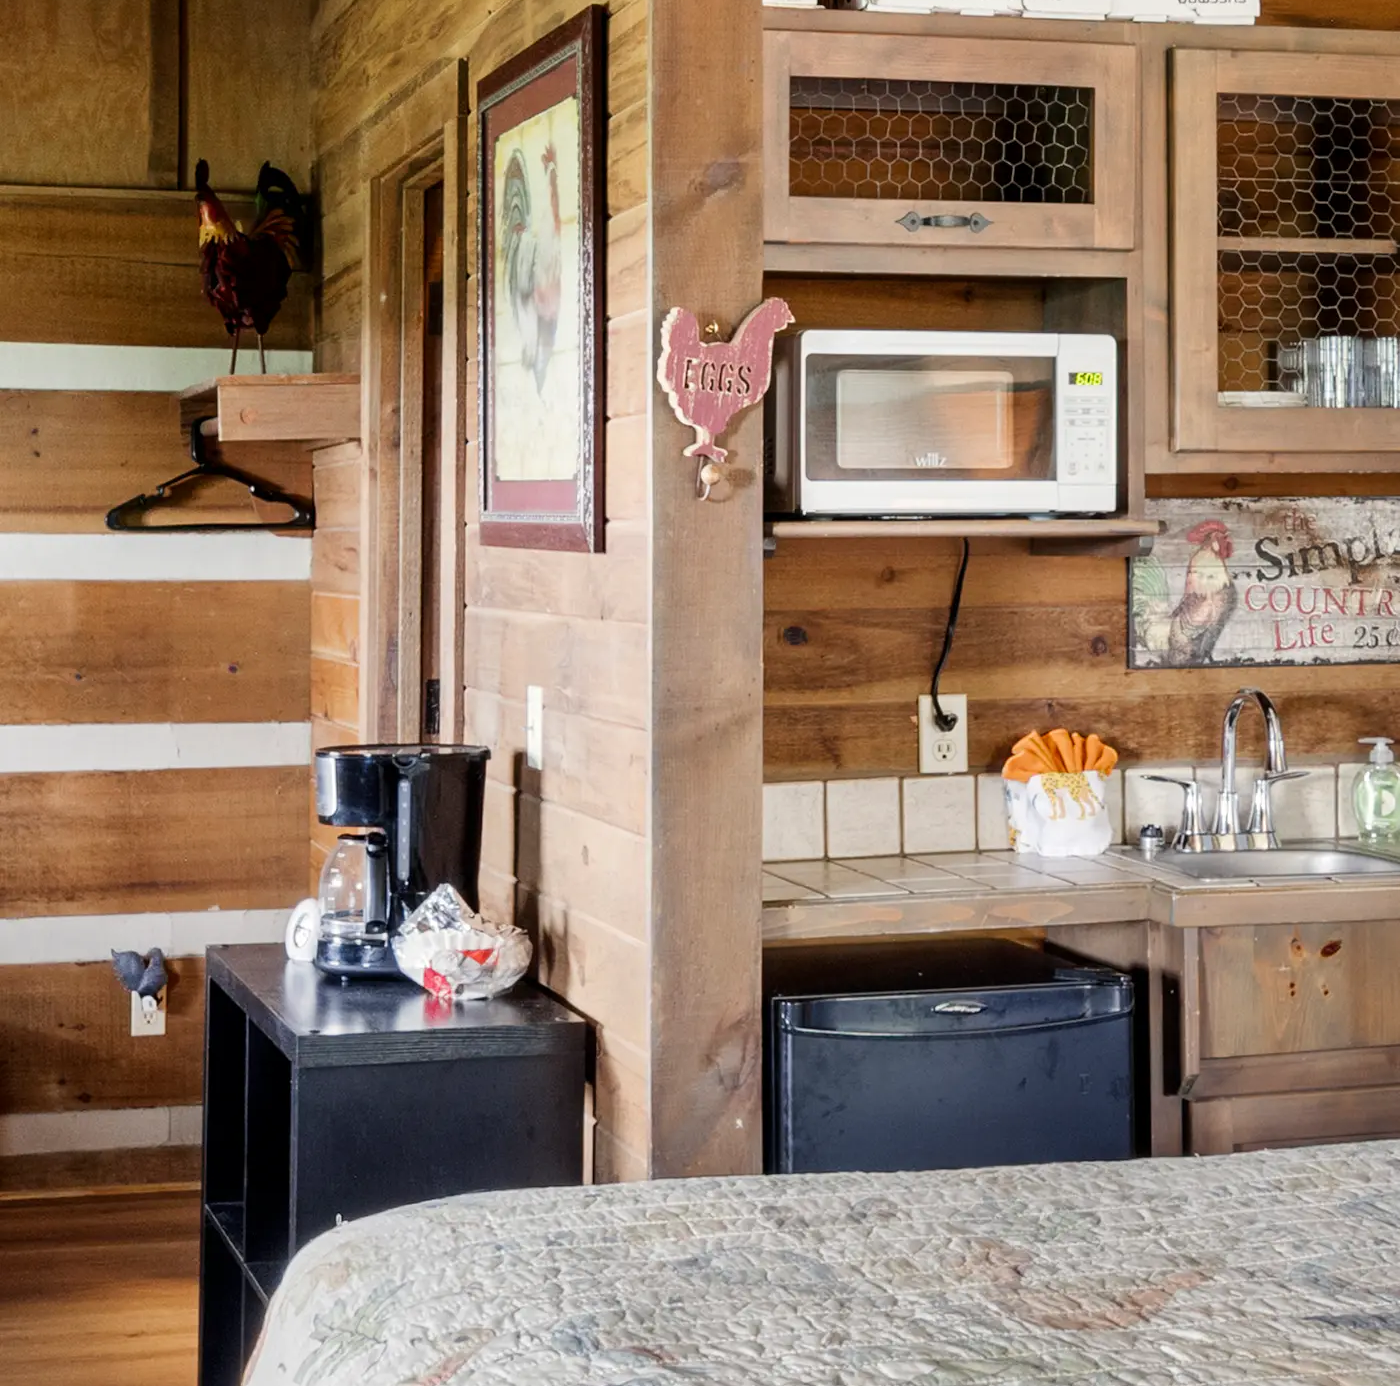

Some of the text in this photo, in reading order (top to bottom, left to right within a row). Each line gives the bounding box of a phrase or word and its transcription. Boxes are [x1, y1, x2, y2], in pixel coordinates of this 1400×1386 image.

[683, 359, 752, 395] EGGS
[1281, 507, 1317, 531] the
[1244, 584, 1400, 617] COUNTR
[1273, 614, 1335, 651] Life
